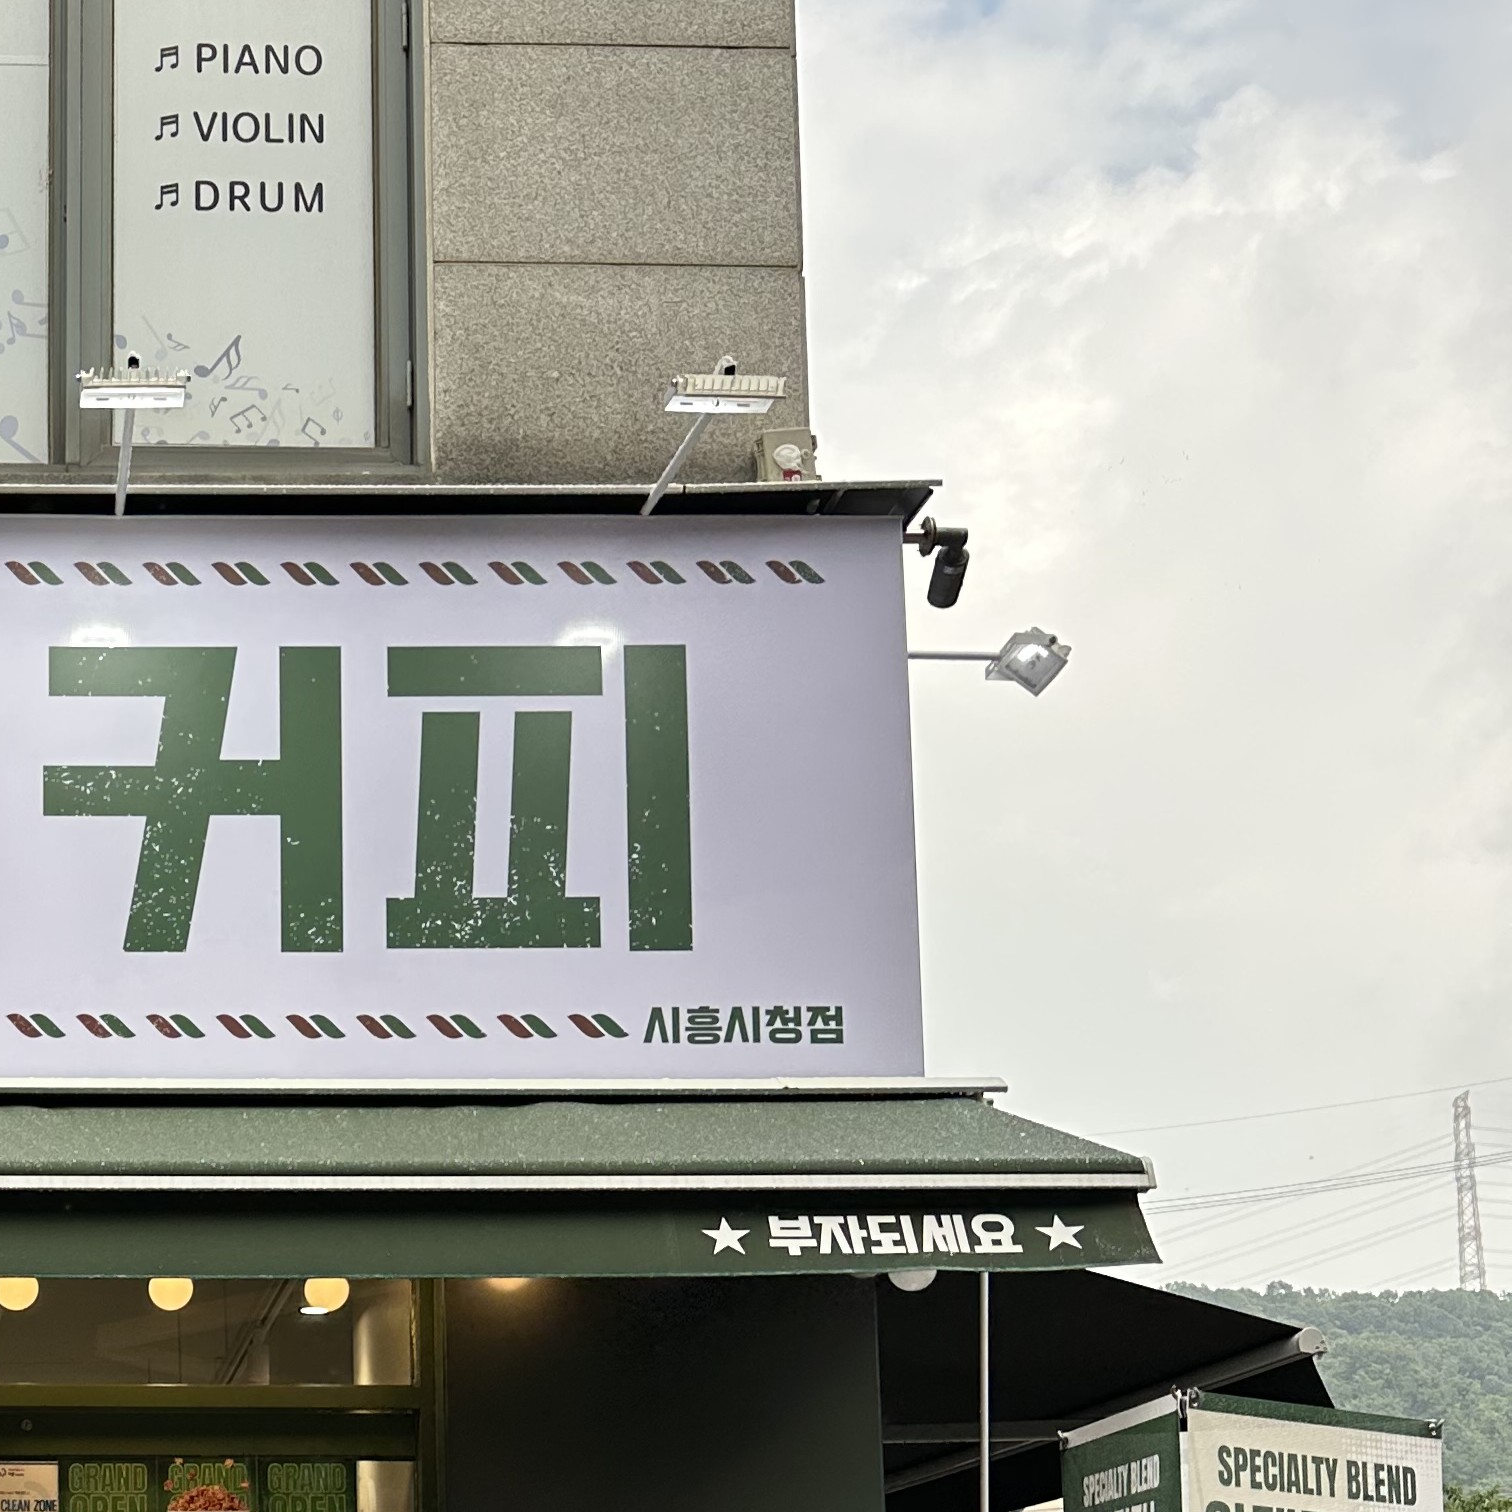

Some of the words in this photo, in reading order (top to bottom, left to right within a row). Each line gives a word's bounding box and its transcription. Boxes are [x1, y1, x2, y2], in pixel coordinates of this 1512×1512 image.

[194, 43, 323, 76] PIANO
[193, 111, 325, 145] VIOLIN
[193, 180, 325, 214] DRUM
[42, 644, 693, 953] 커피
[643, 1005, 844, 1045] 시흥시청점
[768, 1213, 1024, 1255] 부자되세요
[68, 1463, 148, 1493] GRAND
[267, 1463, 347, 1493] GRAND
[1083, 1463, 1129, 1507] SPECIALTY
[1130, 1454, 1161, 1495] BLEND
[1217, 1444, 1338, 1498] SPECIALTY
[1346, 1459, 1417, 1506] BLEND
[0, 1499, 30, 1512] CLEAN
[34, 1499, 57, 1512] ZONE
